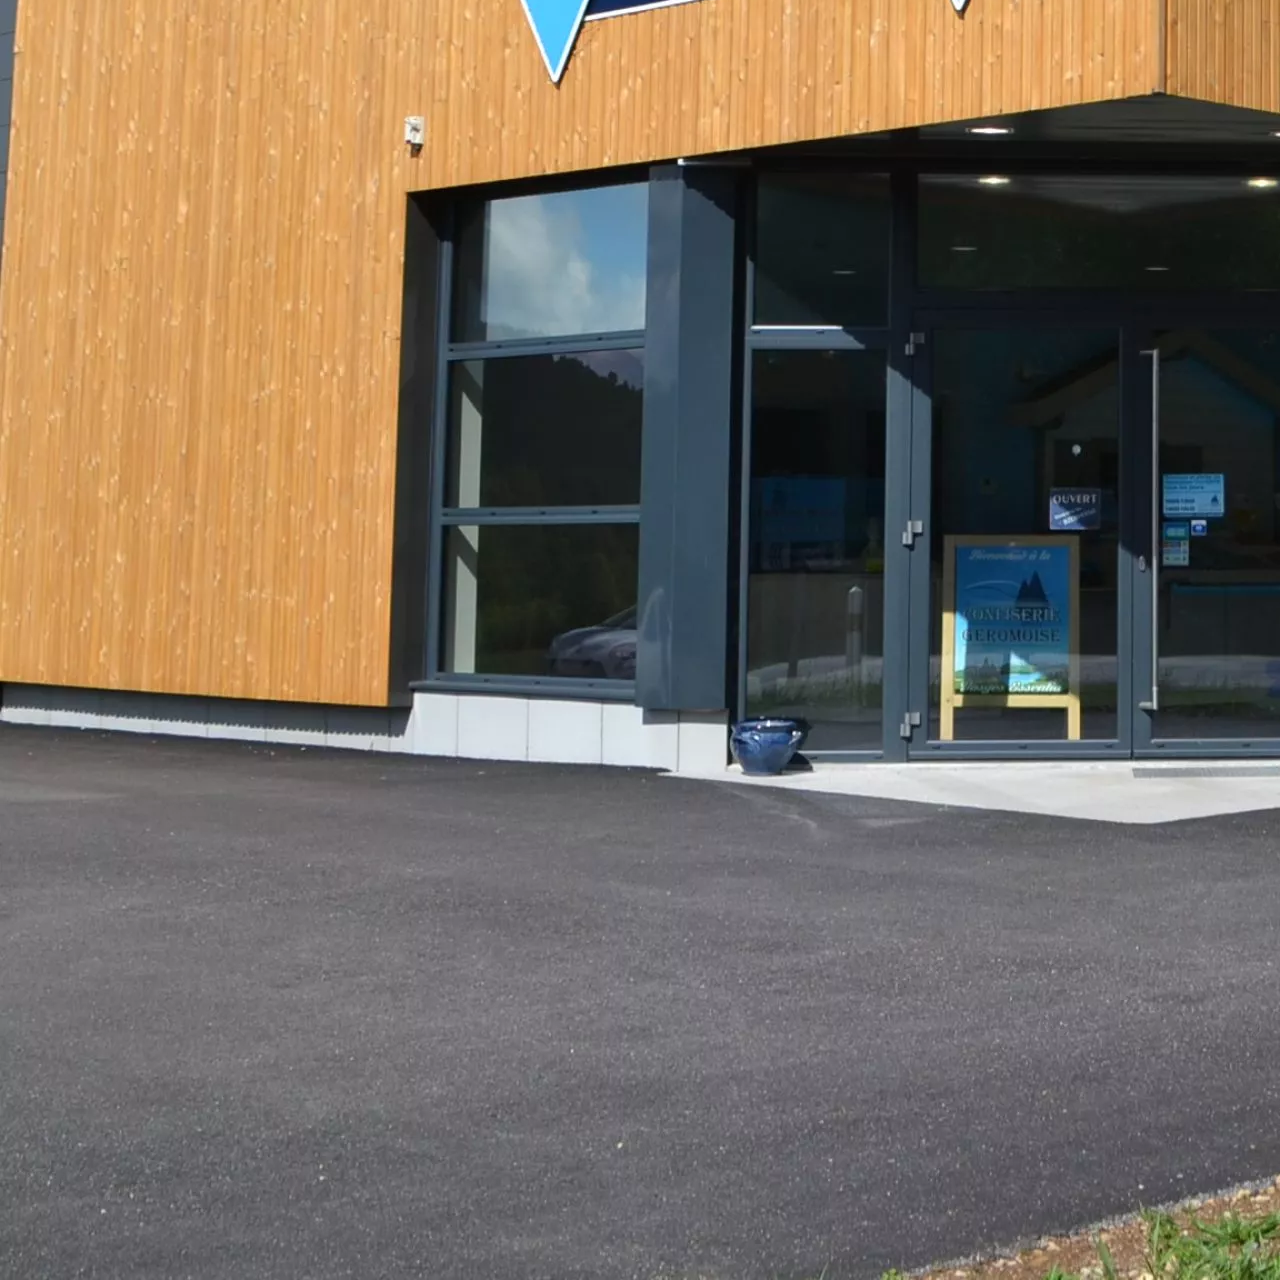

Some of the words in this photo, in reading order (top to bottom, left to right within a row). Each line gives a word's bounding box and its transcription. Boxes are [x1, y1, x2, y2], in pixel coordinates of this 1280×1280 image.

[1052, 493, 1098, 505] OUVERT
[963, 607, 1061, 622] CONFISERIE
[961, 628, 1061, 642] GEROMOISE
